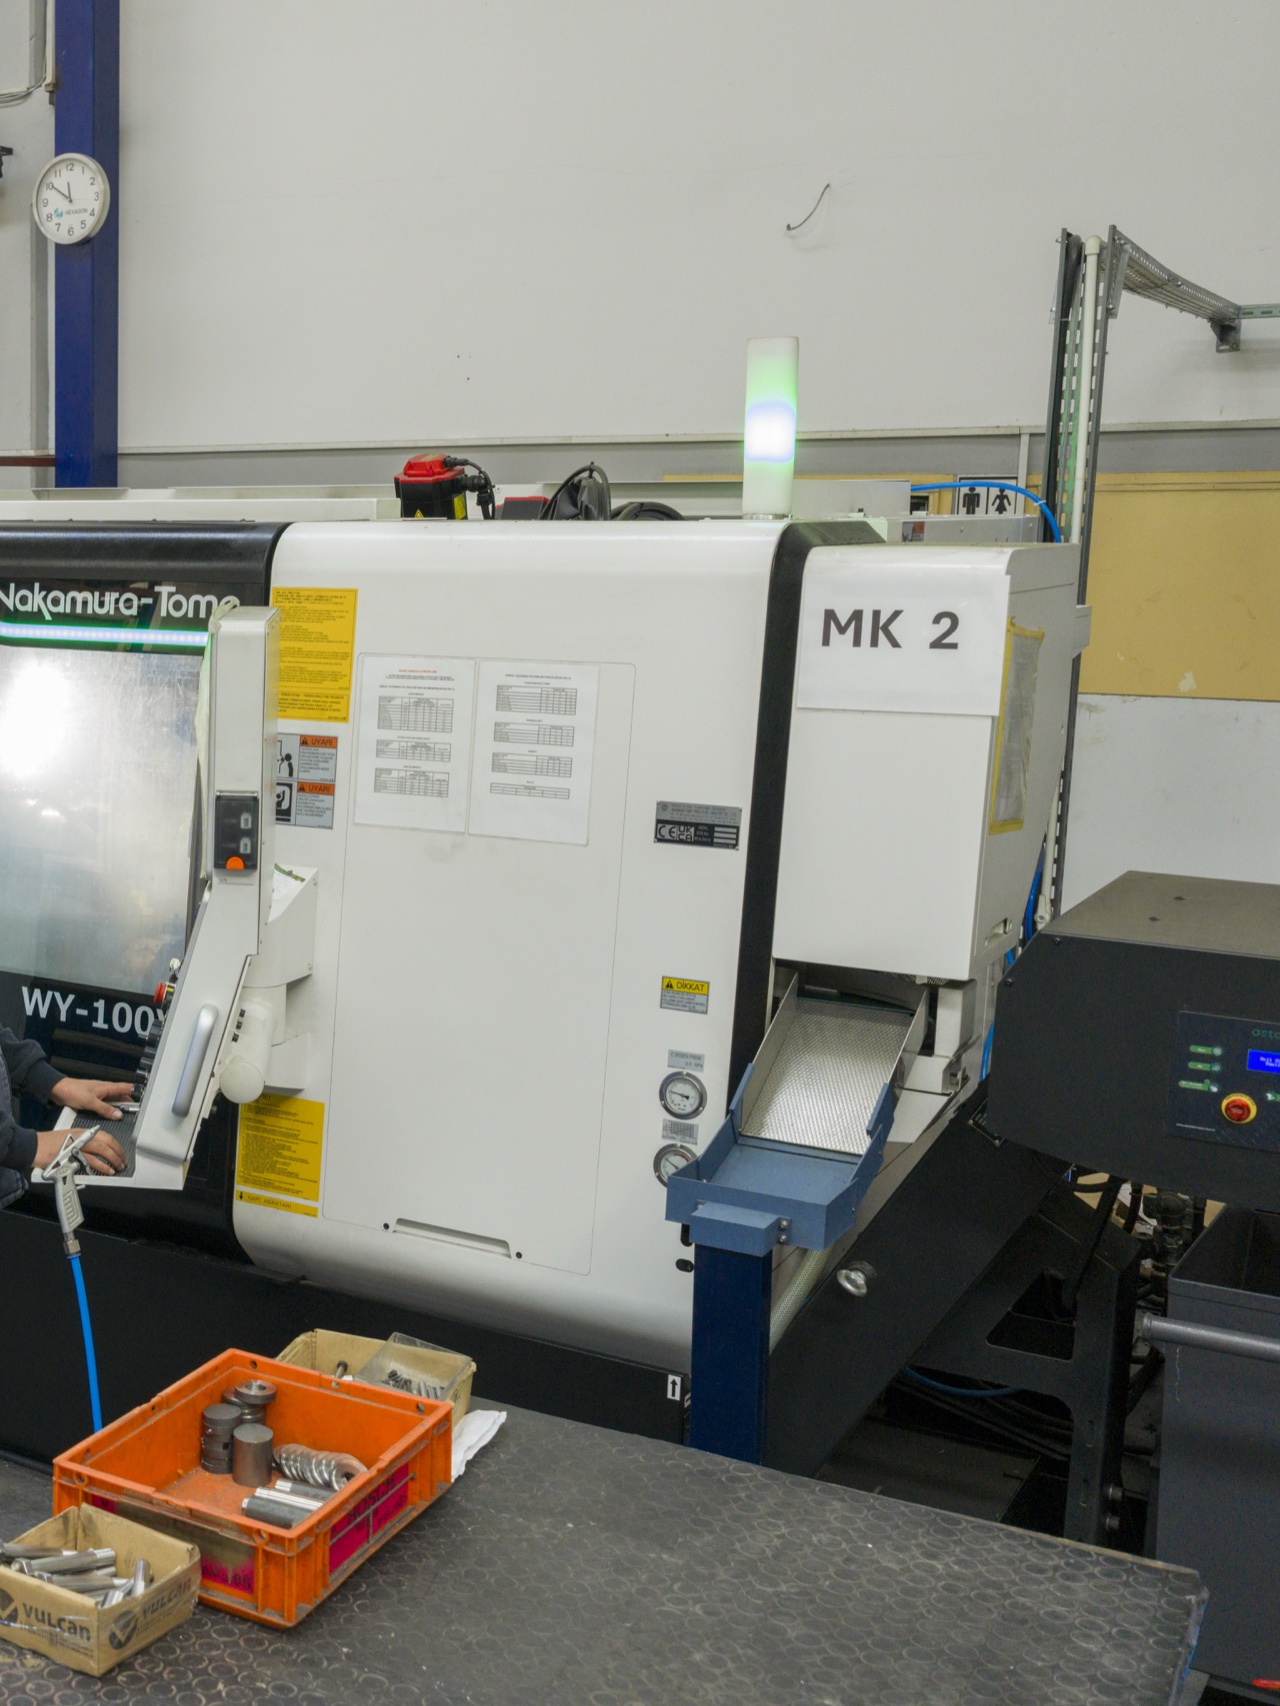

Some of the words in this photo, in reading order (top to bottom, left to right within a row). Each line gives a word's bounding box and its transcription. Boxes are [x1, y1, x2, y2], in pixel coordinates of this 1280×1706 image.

[66, 162, 74, 172] 12
[54, 170, 62, 178] 11
[46, 181, 54, 190] 10
[90, 177, 96, 186] 2
[94, 192, 99, 201] 3
[42, 198, 48, 207] 9
[65, 208, 88, 216] HEXAGON
[89, 208, 95, 217] 4
[46, 213, 53, 222] 8
[55, 223, 61, 232] 7
[80, 220, 86, 229] 5
[68, 227, 74, 236] 6
[822, 608, 904, 648] MK
[929, 611, 959, 649] 2
[676, 980, 704, 992] DİKKAT
